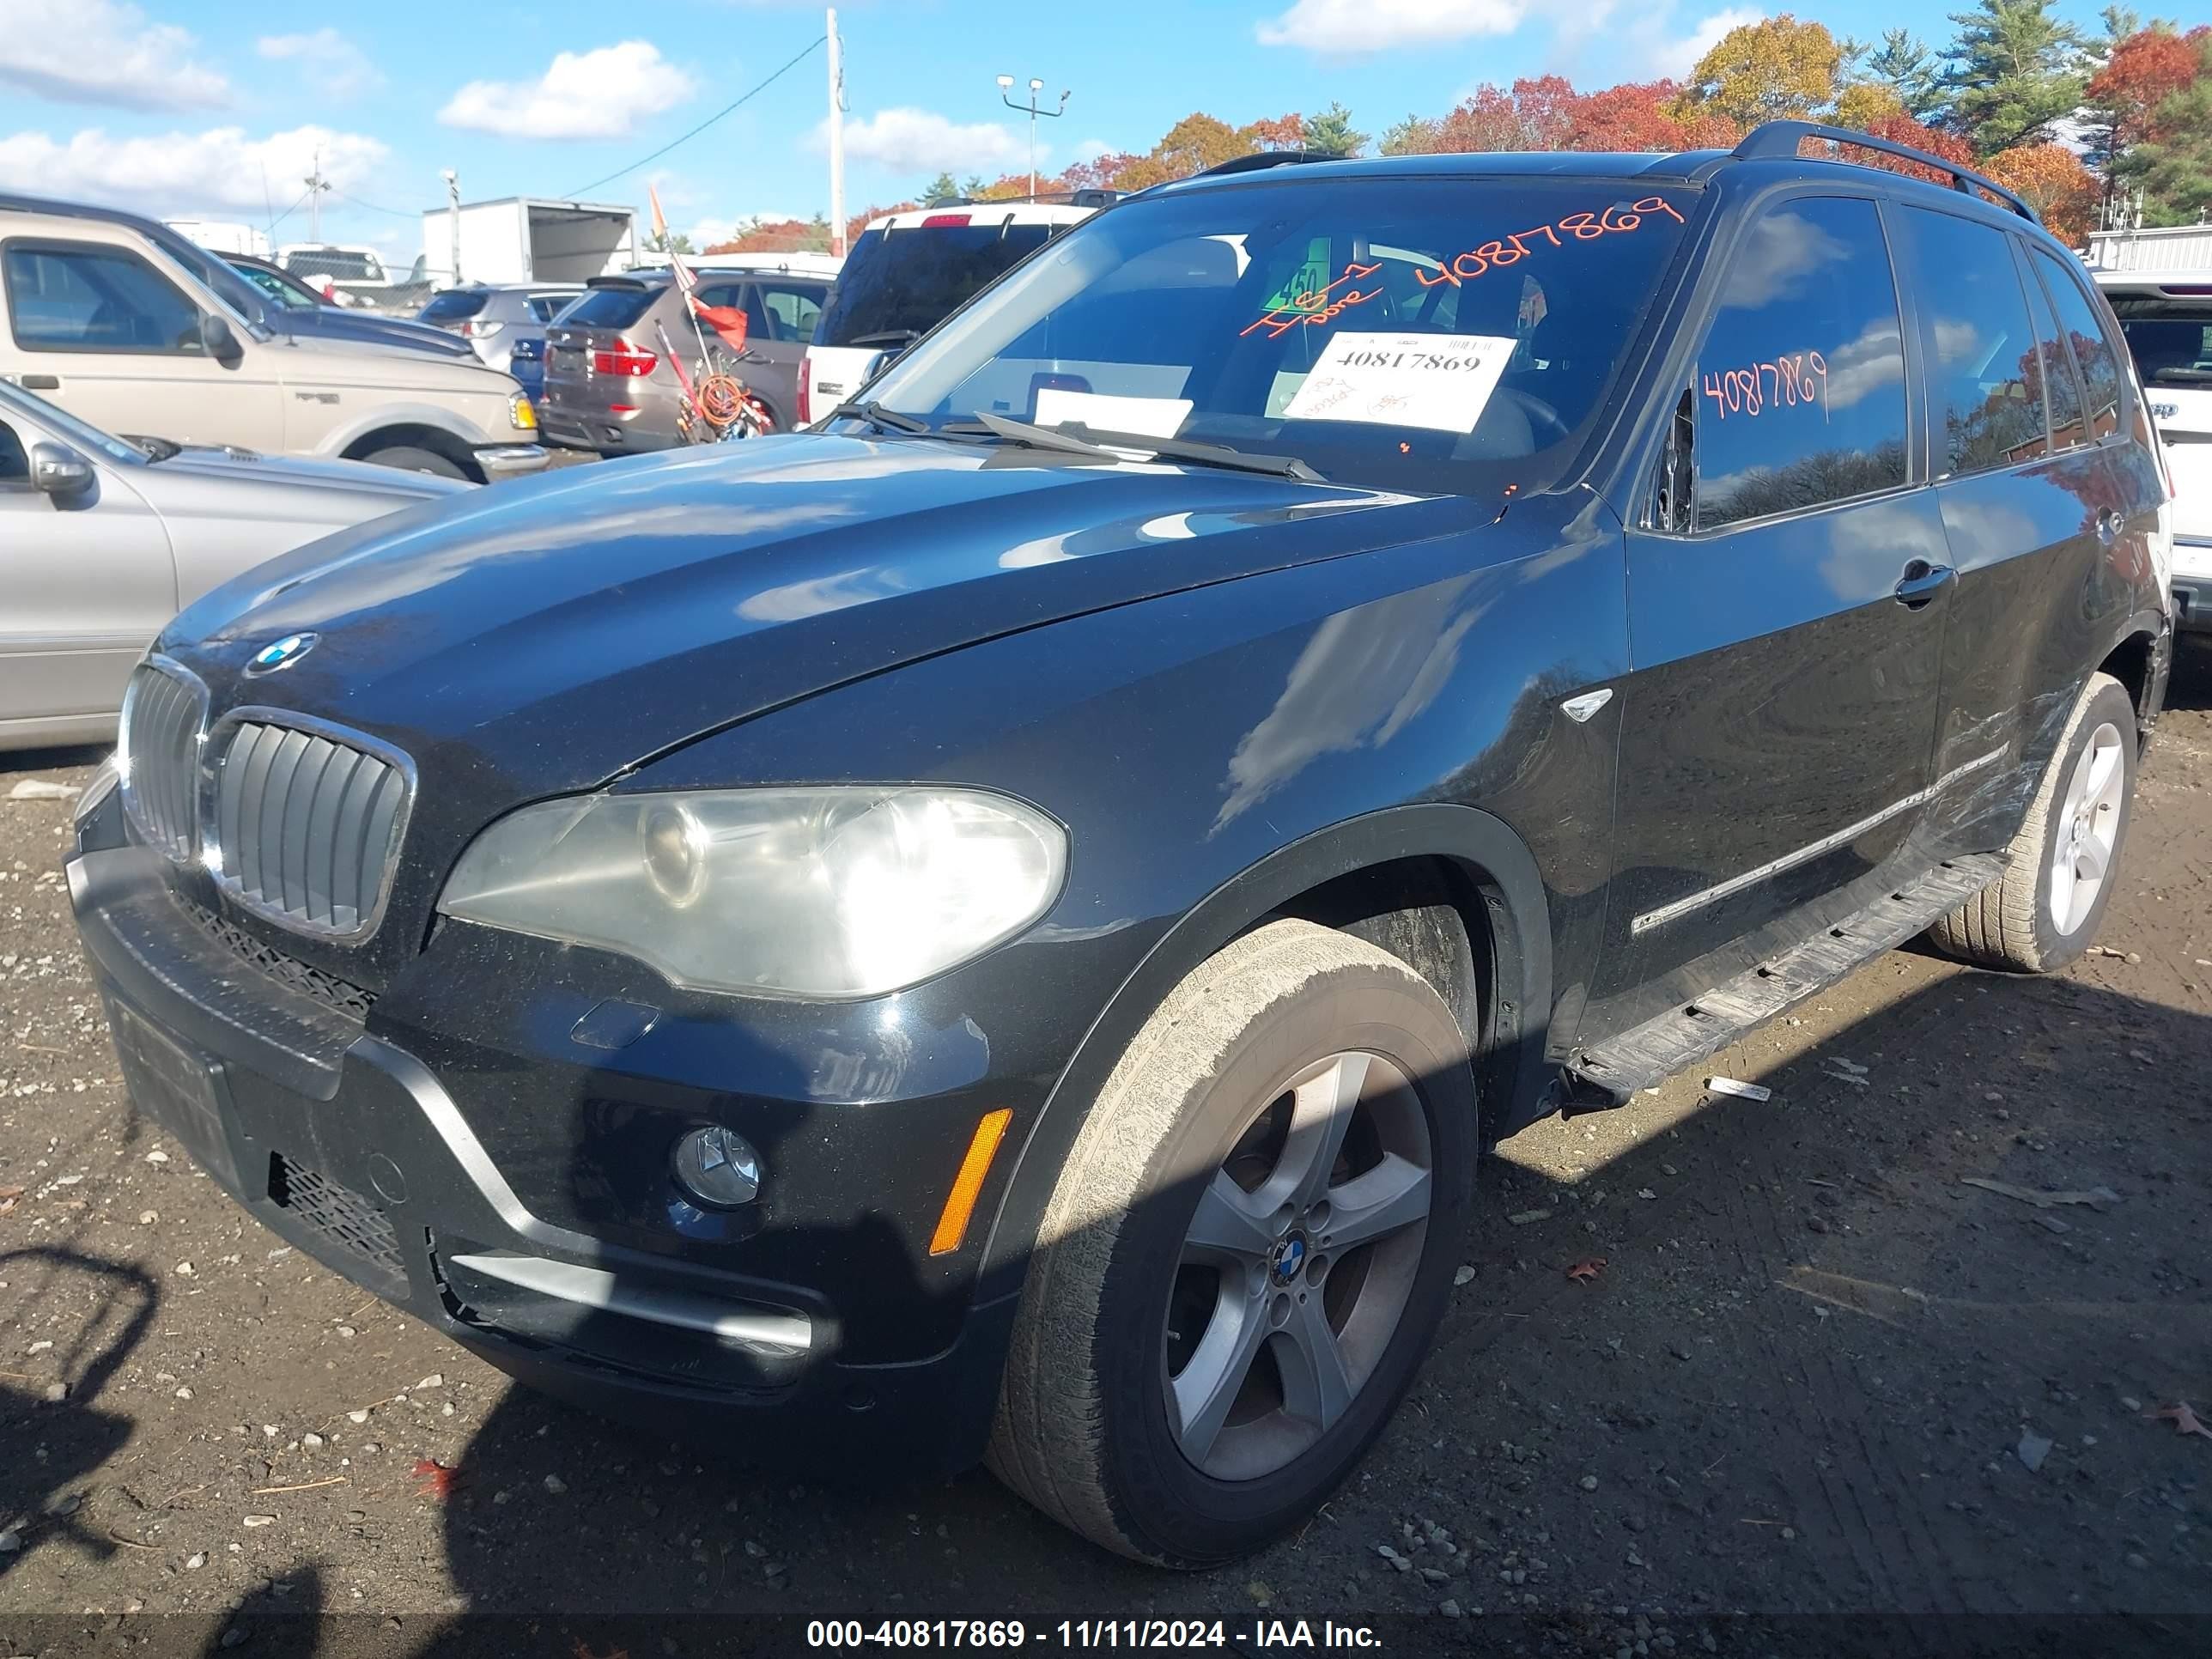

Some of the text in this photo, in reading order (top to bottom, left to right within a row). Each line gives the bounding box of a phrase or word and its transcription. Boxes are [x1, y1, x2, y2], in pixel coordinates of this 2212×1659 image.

[1414, 196, 1686, 289] 40817869
[1336, 350, 1481, 372] 40817869
[1704, 350, 1830, 425] 40817869
